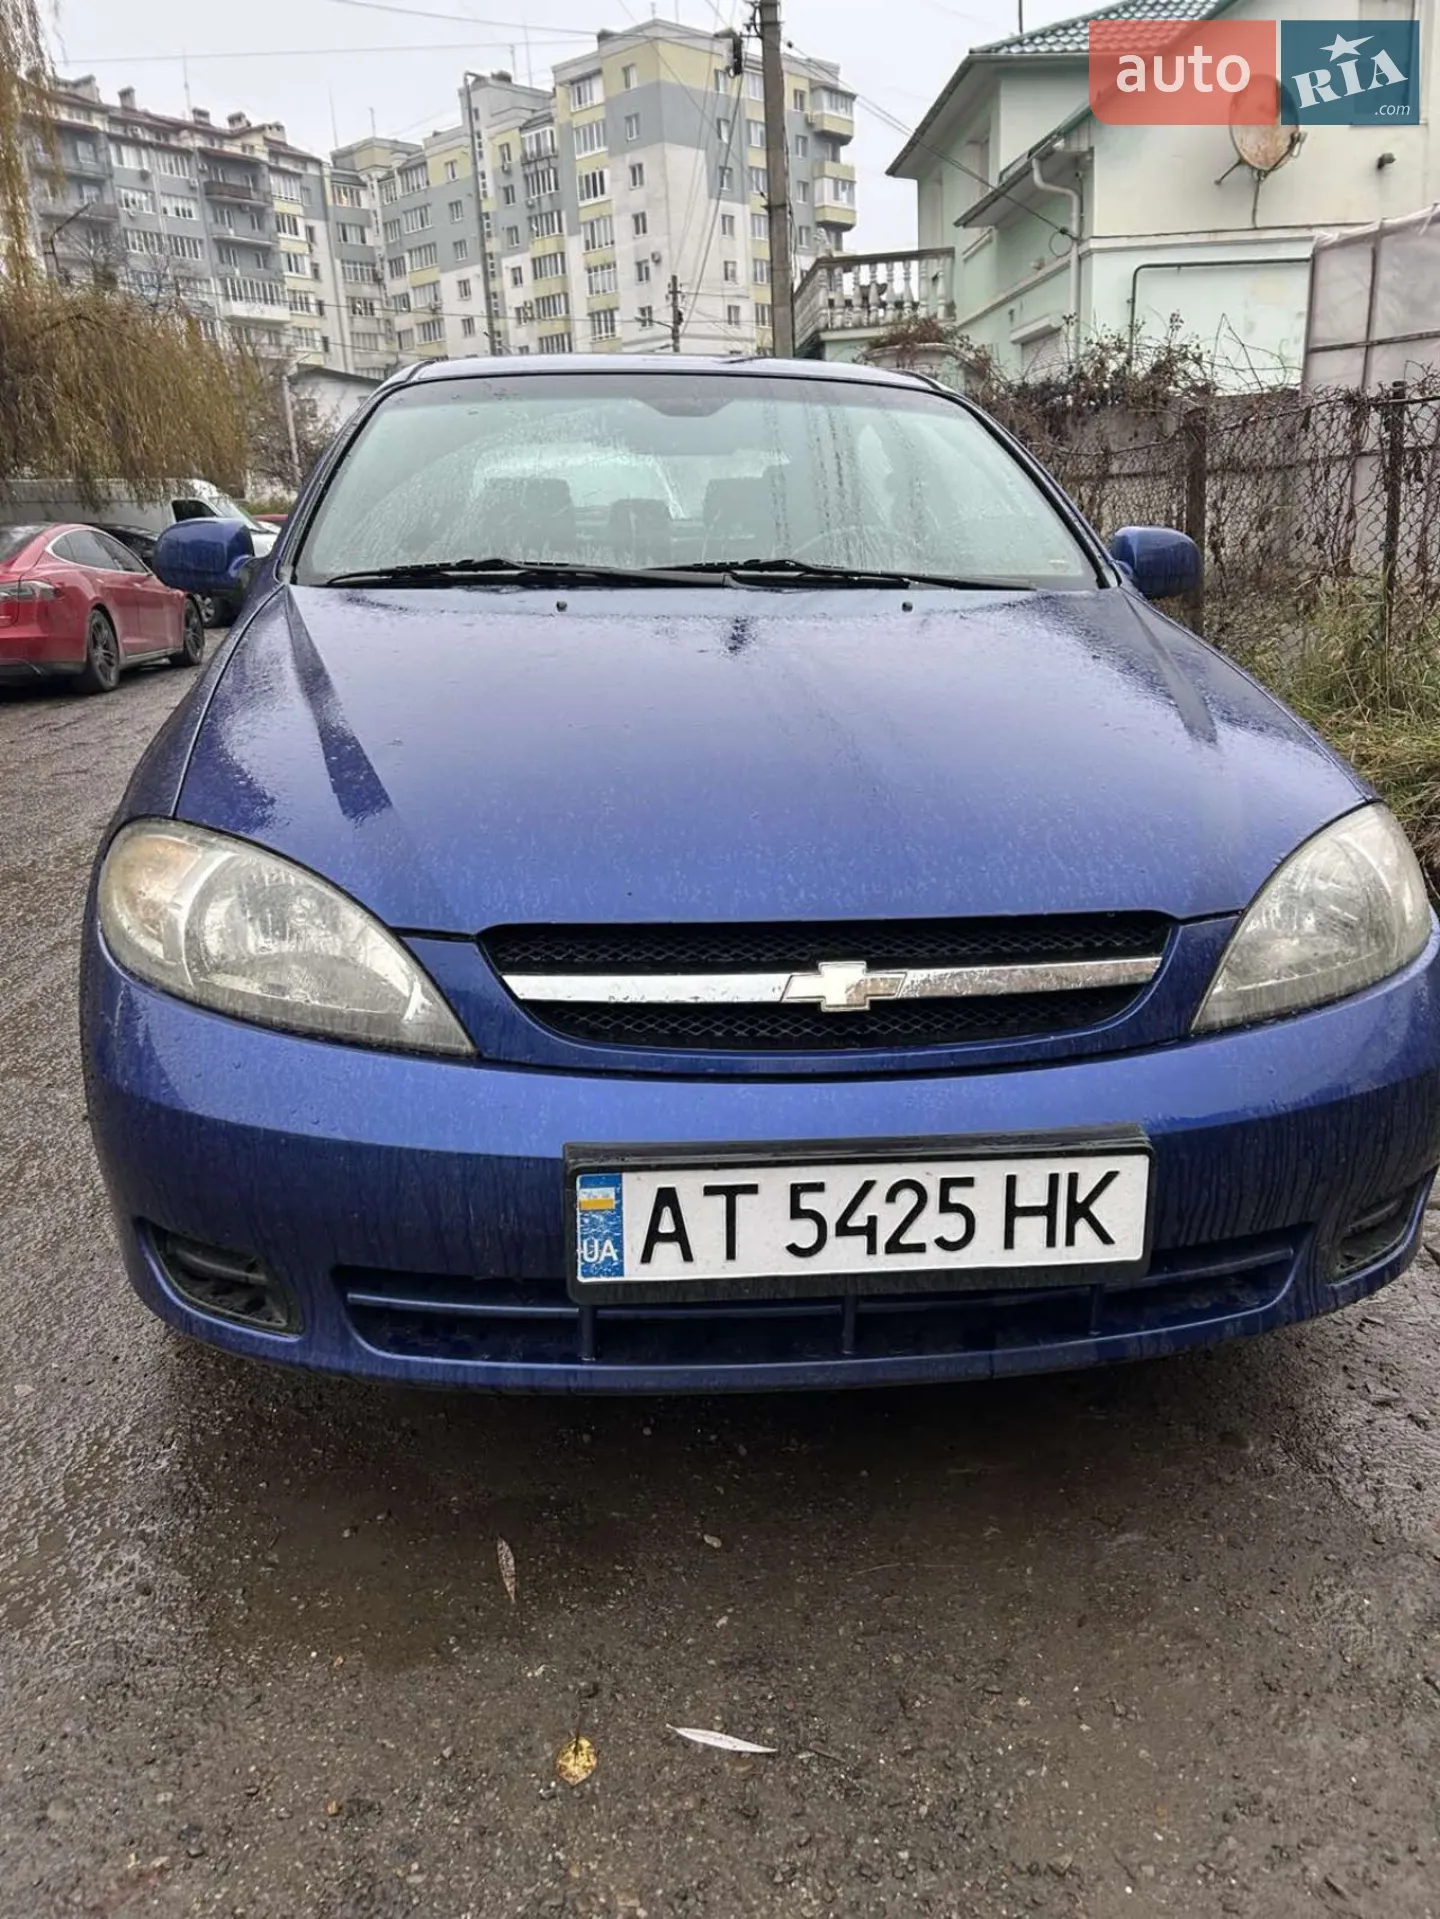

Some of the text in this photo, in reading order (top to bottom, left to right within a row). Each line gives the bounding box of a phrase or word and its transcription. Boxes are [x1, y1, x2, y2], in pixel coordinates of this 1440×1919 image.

[640, 1170, 1120, 1264] AT 5425 HK
[583, 1238, 618, 1263] UA
